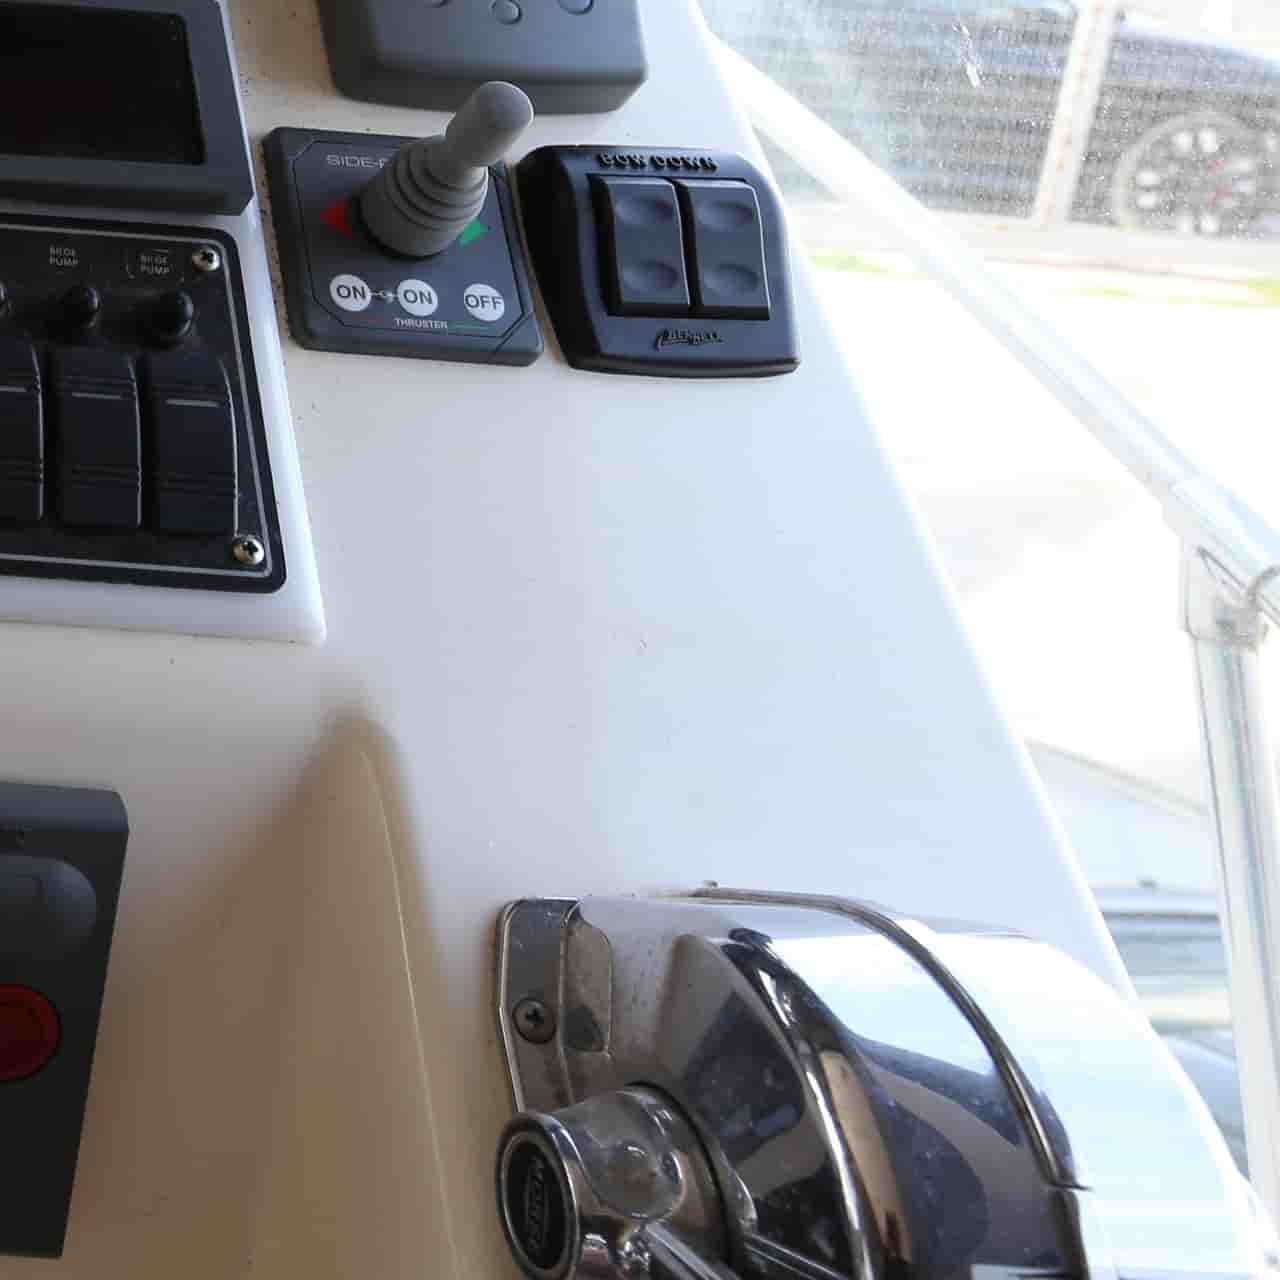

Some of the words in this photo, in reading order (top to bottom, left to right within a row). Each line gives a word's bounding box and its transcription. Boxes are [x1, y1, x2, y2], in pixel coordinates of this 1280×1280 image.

[326, 154, 389, 169] SIDE-P
[335, 284, 367, 300] ON
[402, 289, 434, 305] ON
[464, 293, 505, 310] OFF
[395, 317, 448, 329] THRUSTER
